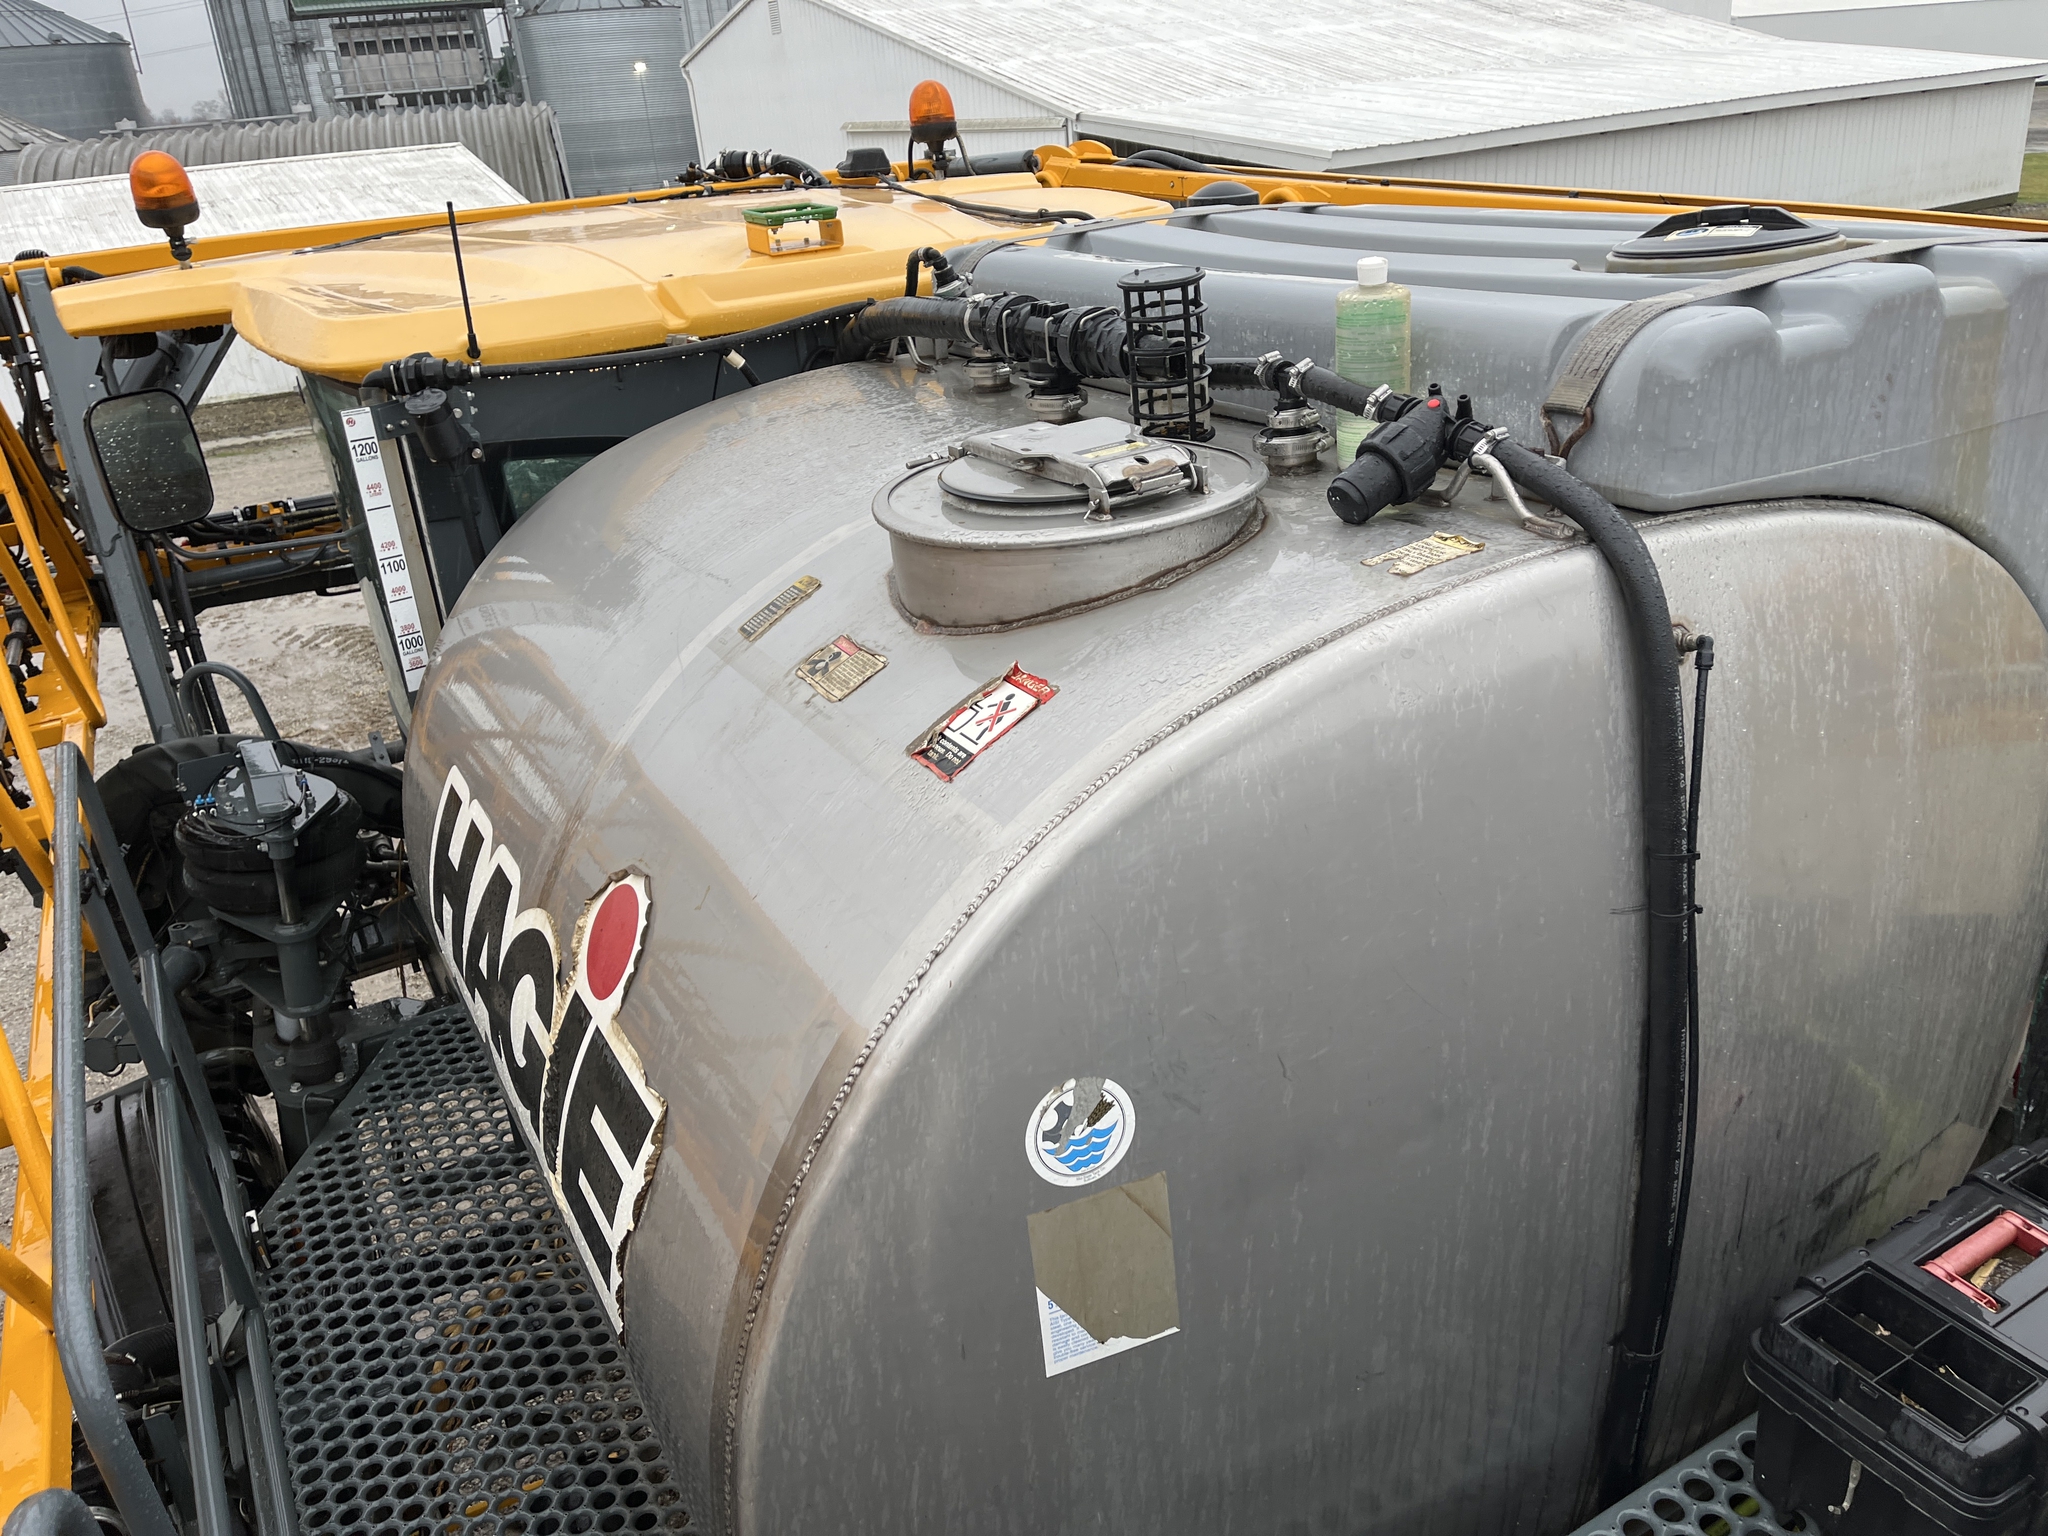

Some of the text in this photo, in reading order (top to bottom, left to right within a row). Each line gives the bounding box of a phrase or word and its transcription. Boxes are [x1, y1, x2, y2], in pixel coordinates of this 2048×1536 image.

[351, 441, 378, 457] 1200
[355, 454, 379, 463] GALLONS
[366, 482, 382, 491] 4400
[380, 540, 396, 549] 4200
[380, 559, 406, 575] 1100
[391, 585, 406, 594] 4000
[400, 623, 415, 632] 3800
[399, 635, 424, 651] 1000
[402, 647, 424, 657] GALLONS
[408, 659, 424, 668] 3600
[1674, 685, 1684, 748] THERMOID
[430, 767, 662, 1312] HAGIE
